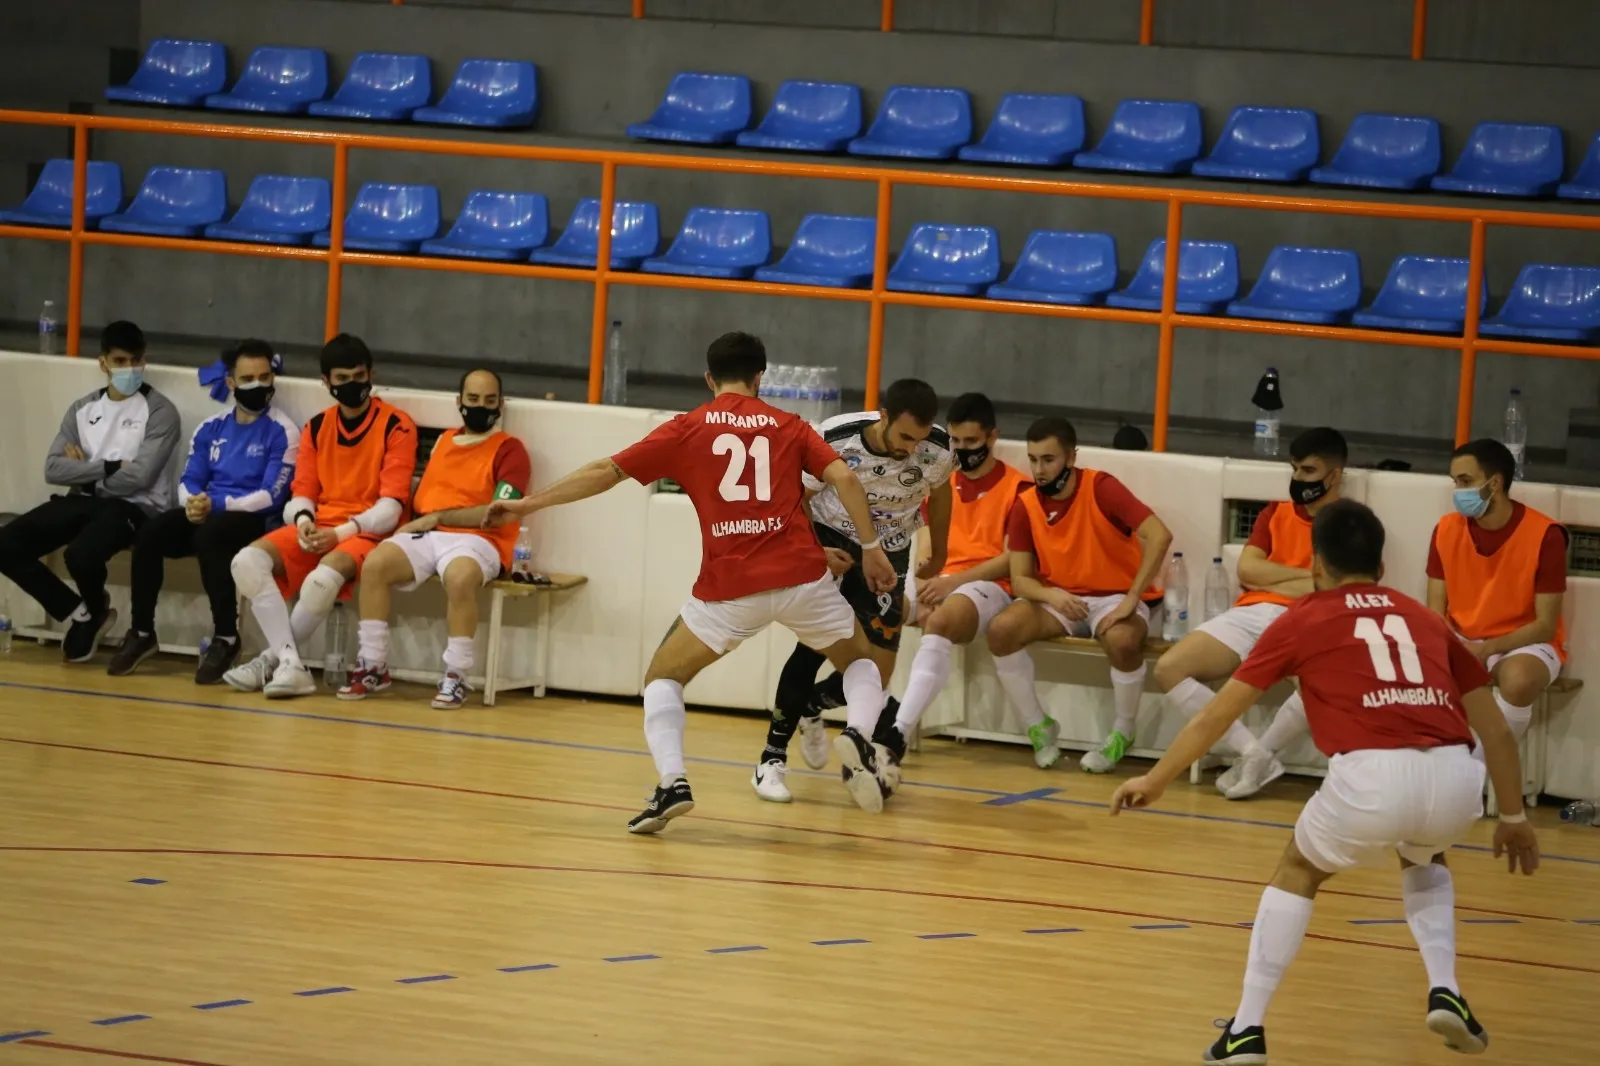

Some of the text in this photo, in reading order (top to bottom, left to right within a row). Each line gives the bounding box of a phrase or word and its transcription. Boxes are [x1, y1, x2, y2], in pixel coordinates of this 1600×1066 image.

[705, 411, 779, 429] MIRANDA
[711, 433, 772, 502] 21
[498, 483, 513, 500] C
[711, 519, 766, 538] ALHAMBRA
[877, 592, 892, 616] 9
[1345, 593, 1396, 609] ALEX
[1353, 613, 1424, 684] 11
[1362, 686, 1436, 708] ALHAMBRA
